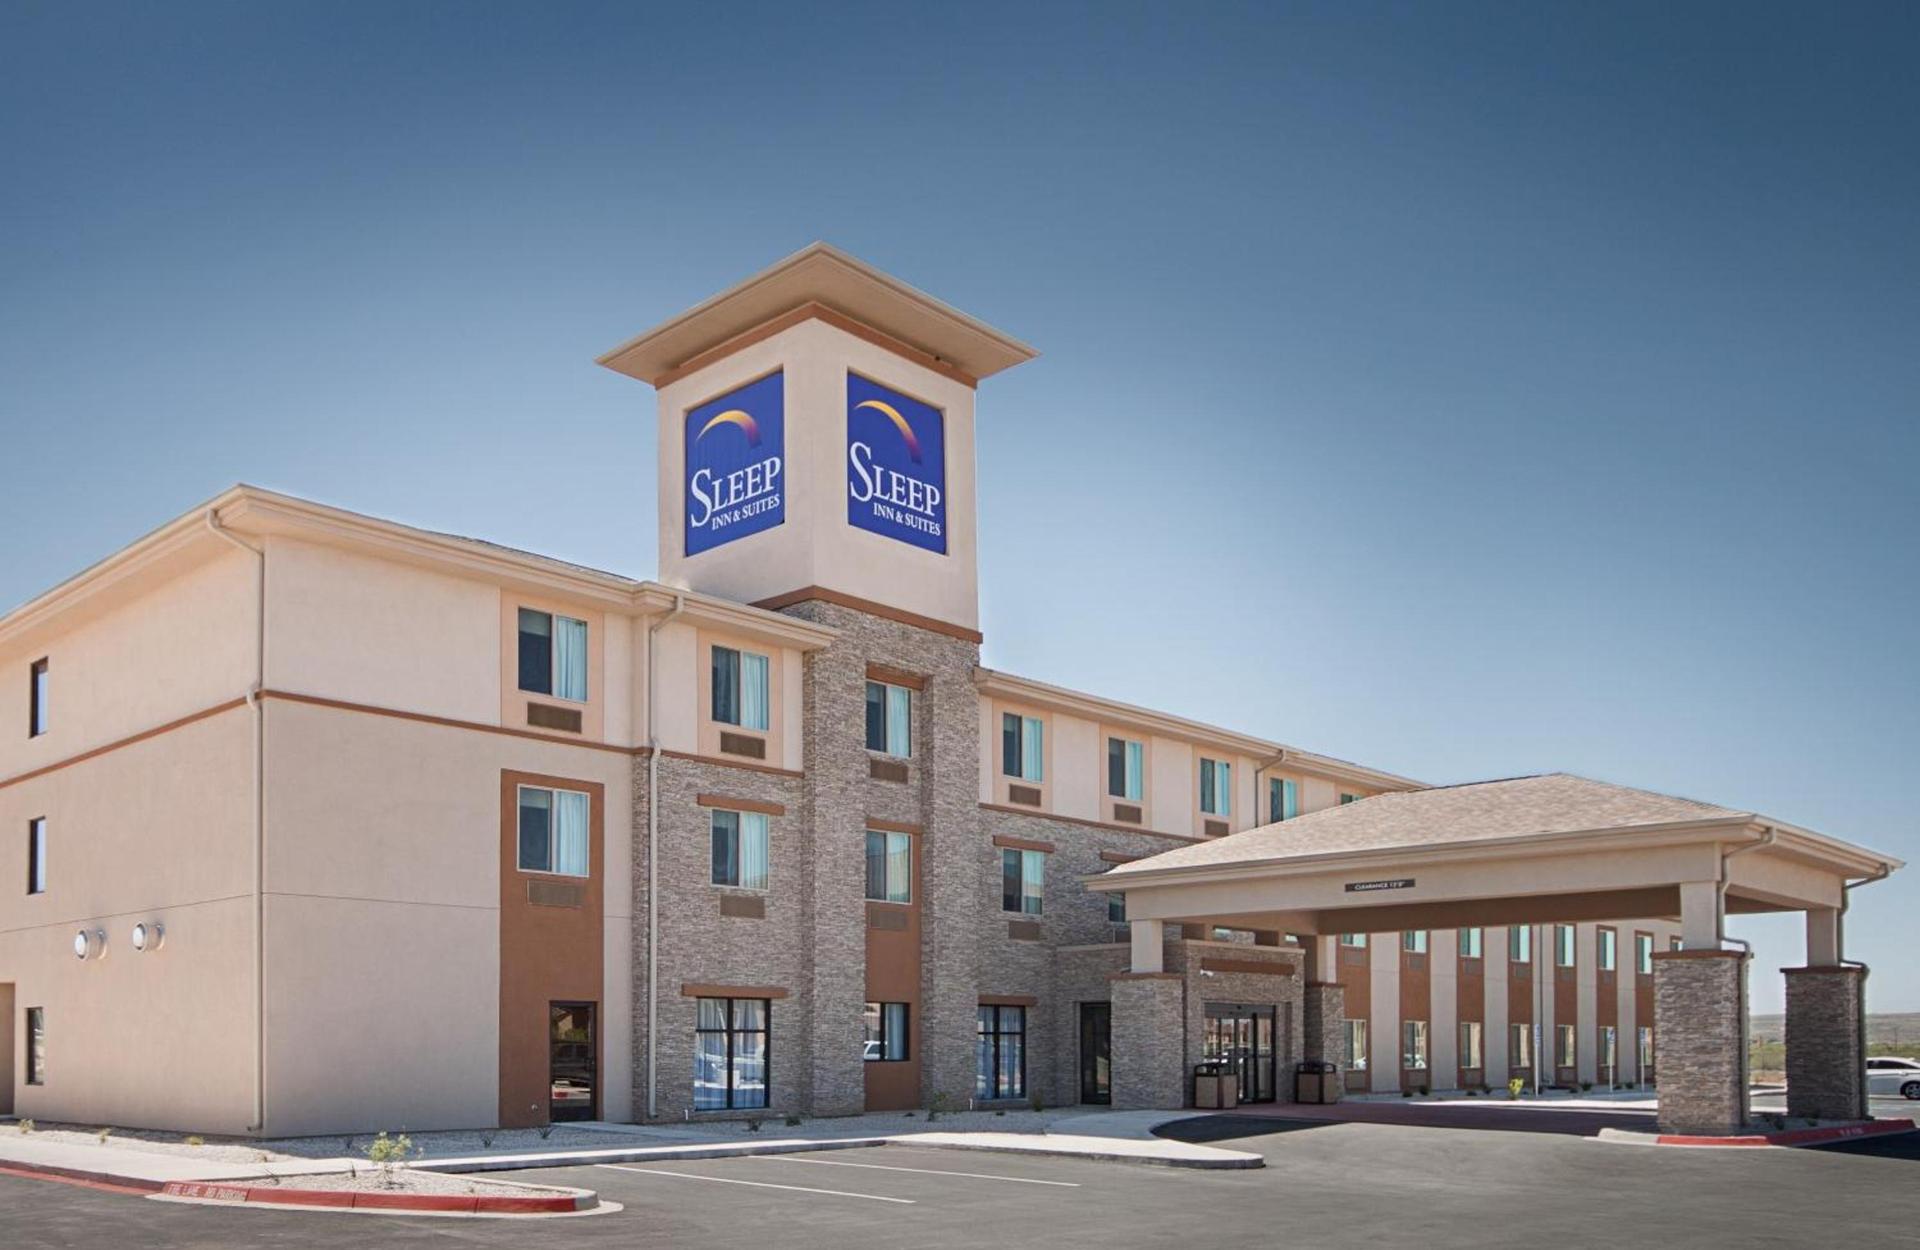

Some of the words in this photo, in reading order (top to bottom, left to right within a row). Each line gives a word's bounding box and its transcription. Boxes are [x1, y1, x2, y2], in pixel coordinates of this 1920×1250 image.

[691, 457, 781, 528] SLEEP
[850, 442, 940, 516] SLEEP
[712, 512, 732, 530] INN
[732, 510, 741, 522] &
[742, 494, 780, 519] SUITES
[873, 503, 894, 520] INN
[895, 511, 904, 524] &
[905, 513, 941, 536] SUITES
